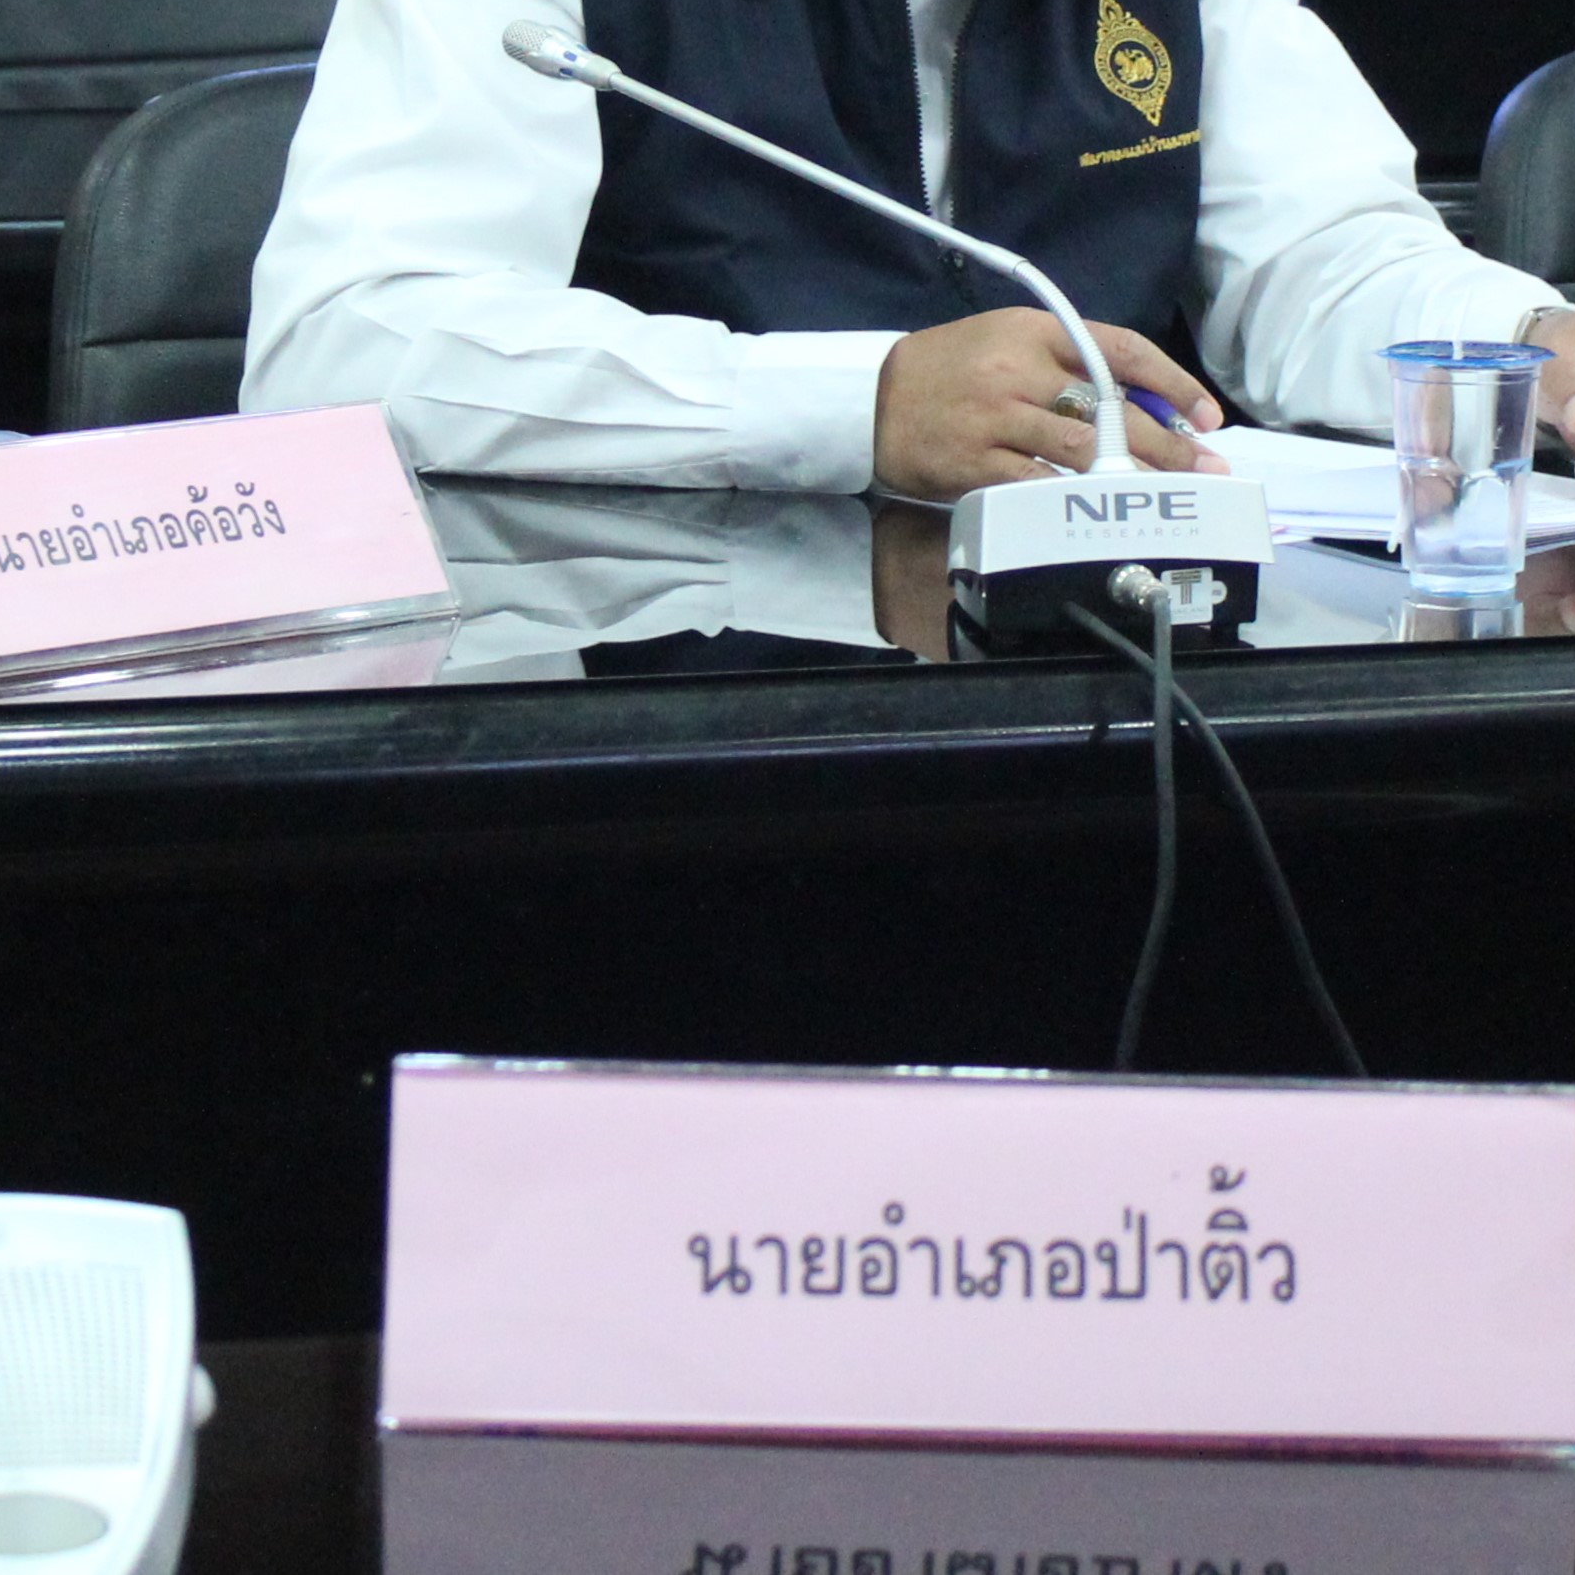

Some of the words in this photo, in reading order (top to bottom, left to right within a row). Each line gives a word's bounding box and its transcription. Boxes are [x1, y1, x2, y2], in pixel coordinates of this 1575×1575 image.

[1065, 491, 1198, 523] NPE
[1066, 527, 1199, 539] RESEARCH
[688, 1166, 1300, 1304] นายอำเภอป่าติ้ว
